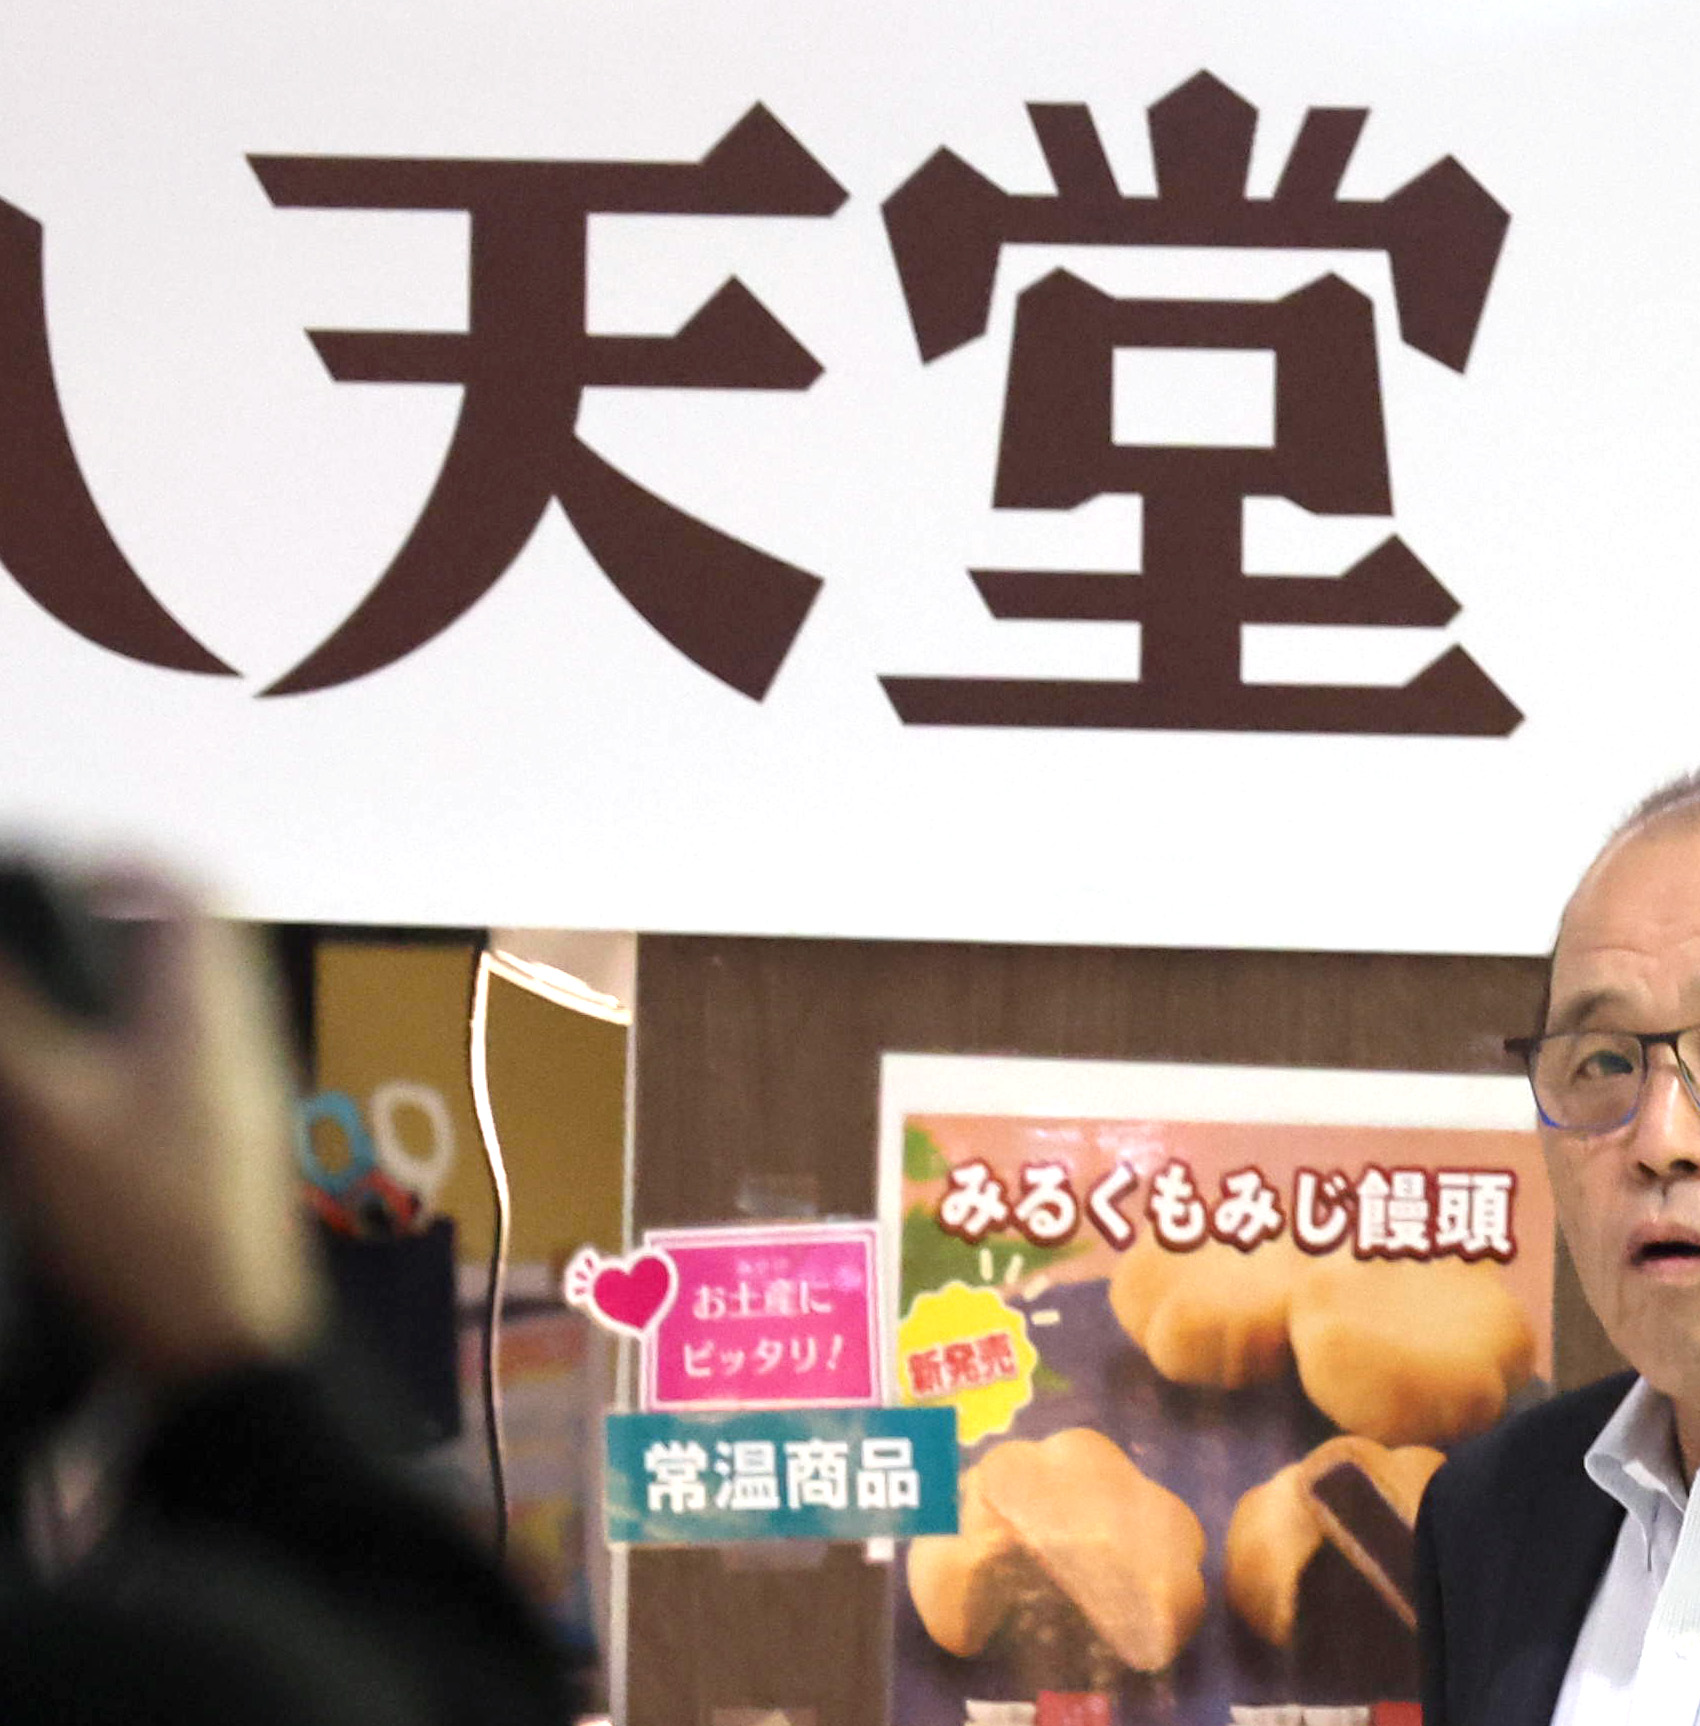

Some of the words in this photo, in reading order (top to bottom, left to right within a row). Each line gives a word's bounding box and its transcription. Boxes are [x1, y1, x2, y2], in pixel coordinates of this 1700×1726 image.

[939, 1160, 1516, 1258] みるくもみじ饅頭
[692, 1278, 833, 1321] お土産に
[908, 1332, 1017, 1396] 新発売
[643, 1437, 921, 1514] 常温商品
